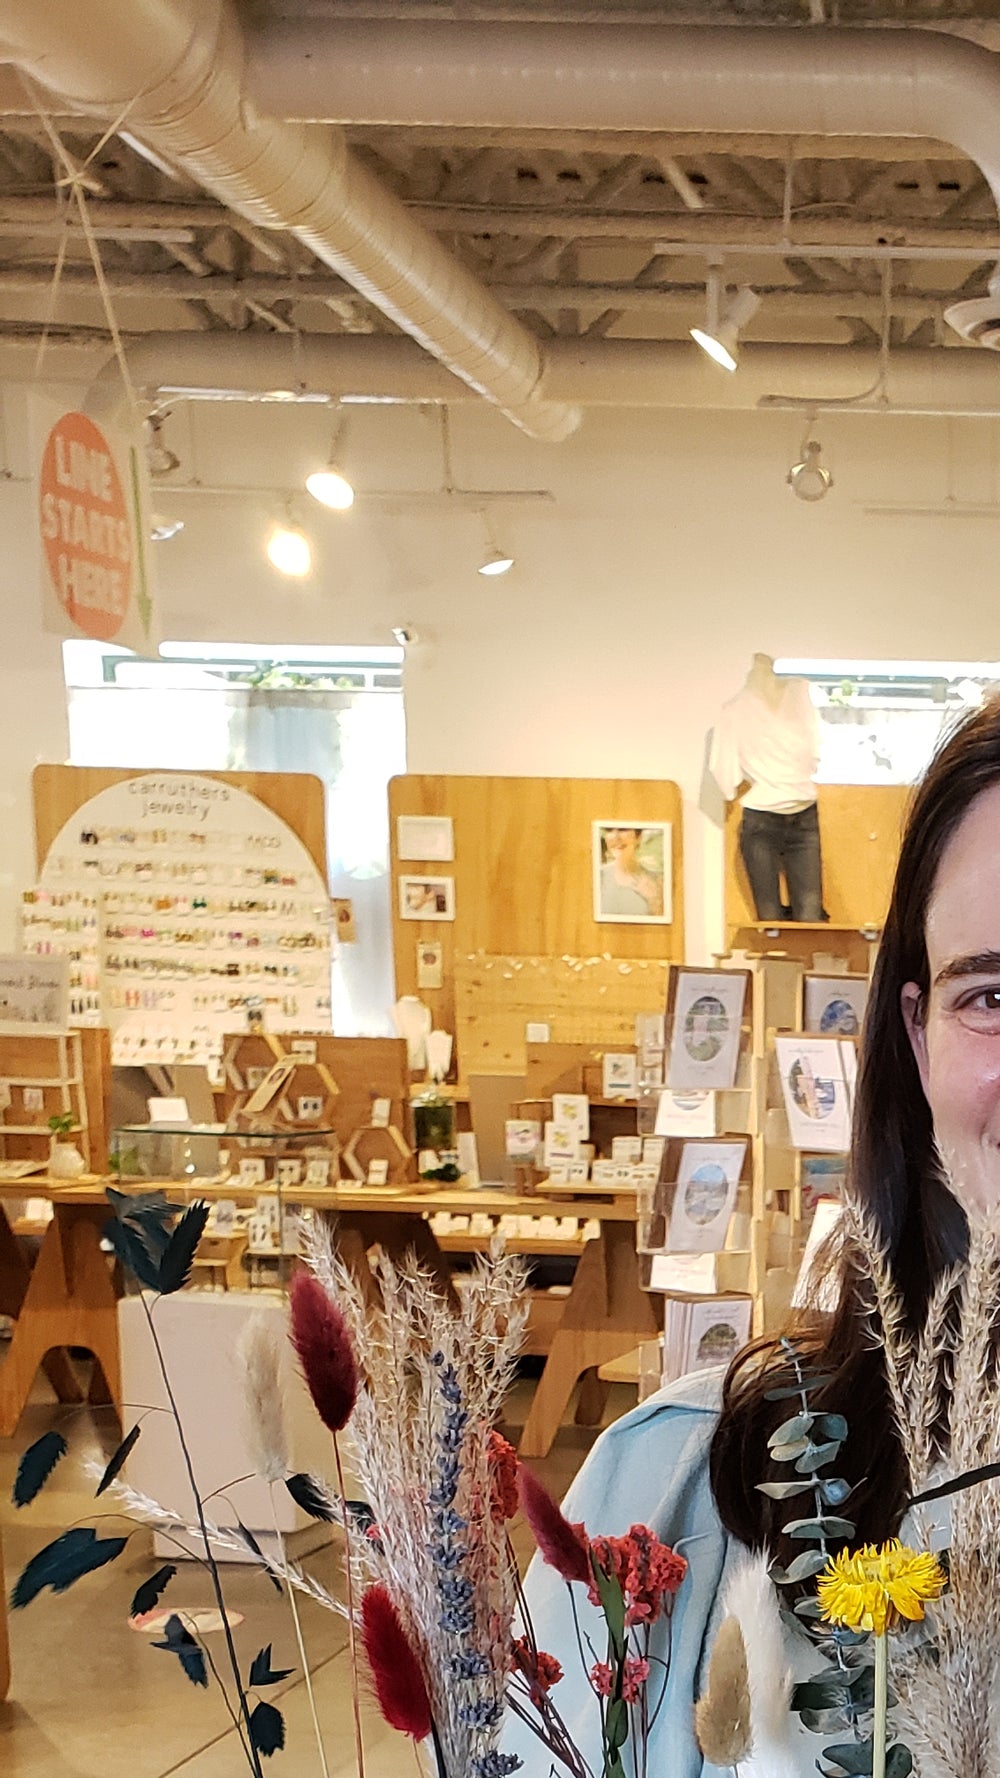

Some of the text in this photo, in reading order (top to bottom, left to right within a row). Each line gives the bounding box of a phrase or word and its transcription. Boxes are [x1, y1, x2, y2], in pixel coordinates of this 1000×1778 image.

[54, 435, 113, 502] LINE
[41, 492, 129, 564] STARTS
[58, 554, 125, 616] HERE
[128, 781, 230, 801] carruthers
[142, 799, 210, 822] jewelry
